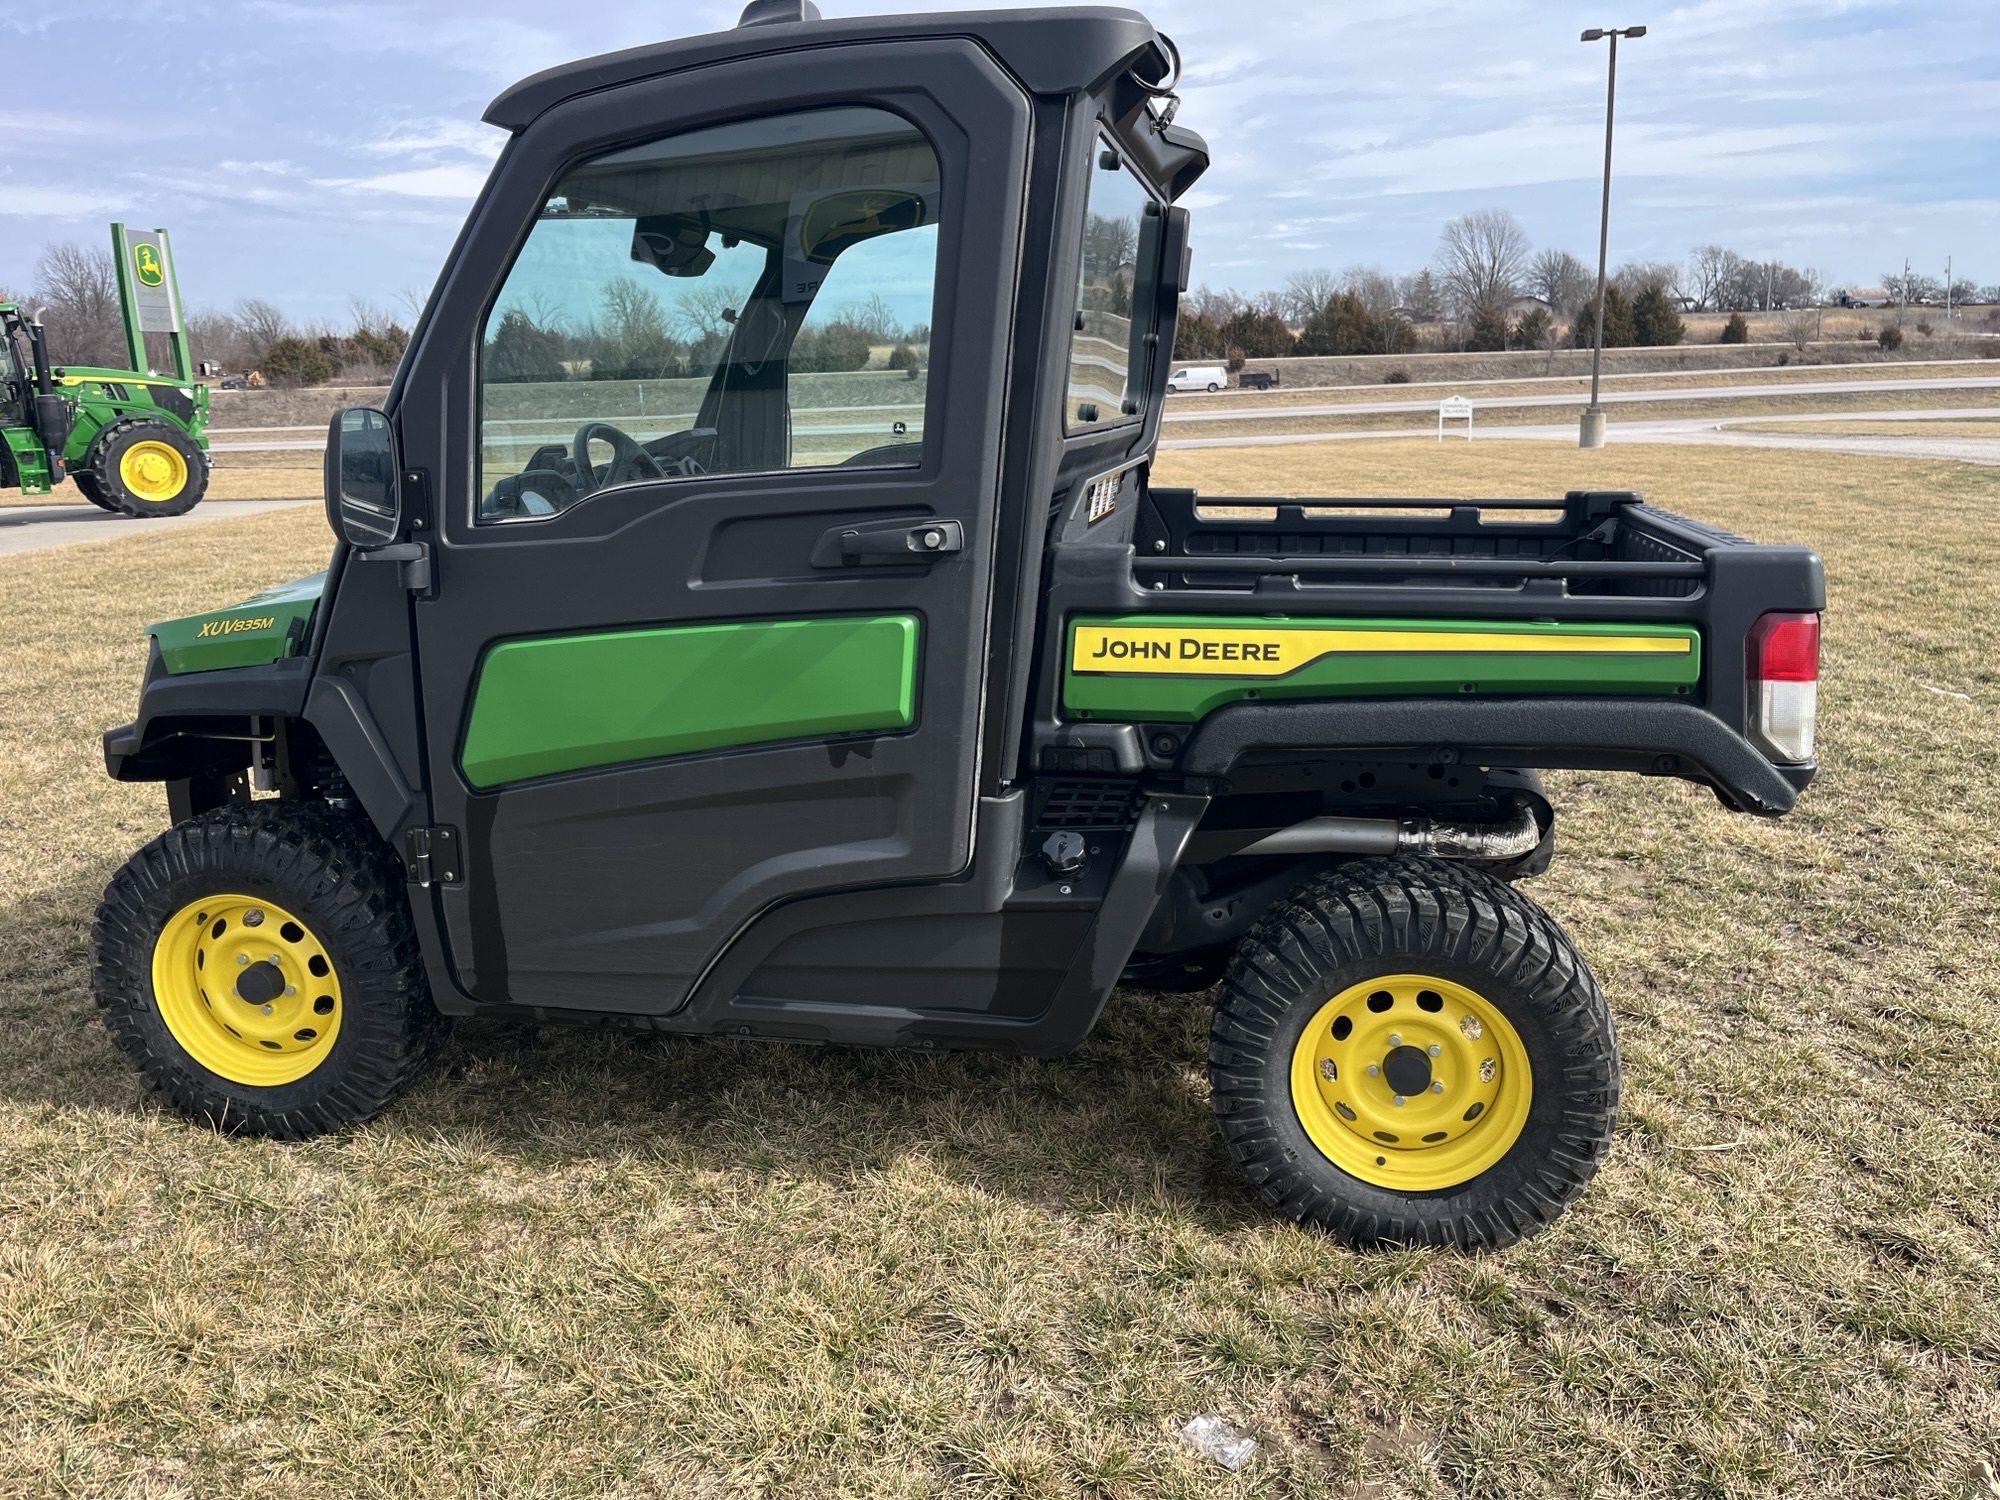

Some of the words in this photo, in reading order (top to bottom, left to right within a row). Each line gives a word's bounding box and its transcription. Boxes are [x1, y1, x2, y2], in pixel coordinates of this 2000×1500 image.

[197, 617, 275, 638] XUV835M
[1092, 637, 1171, 659] JOHN
[1180, 638, 1281, 661] DEERE
